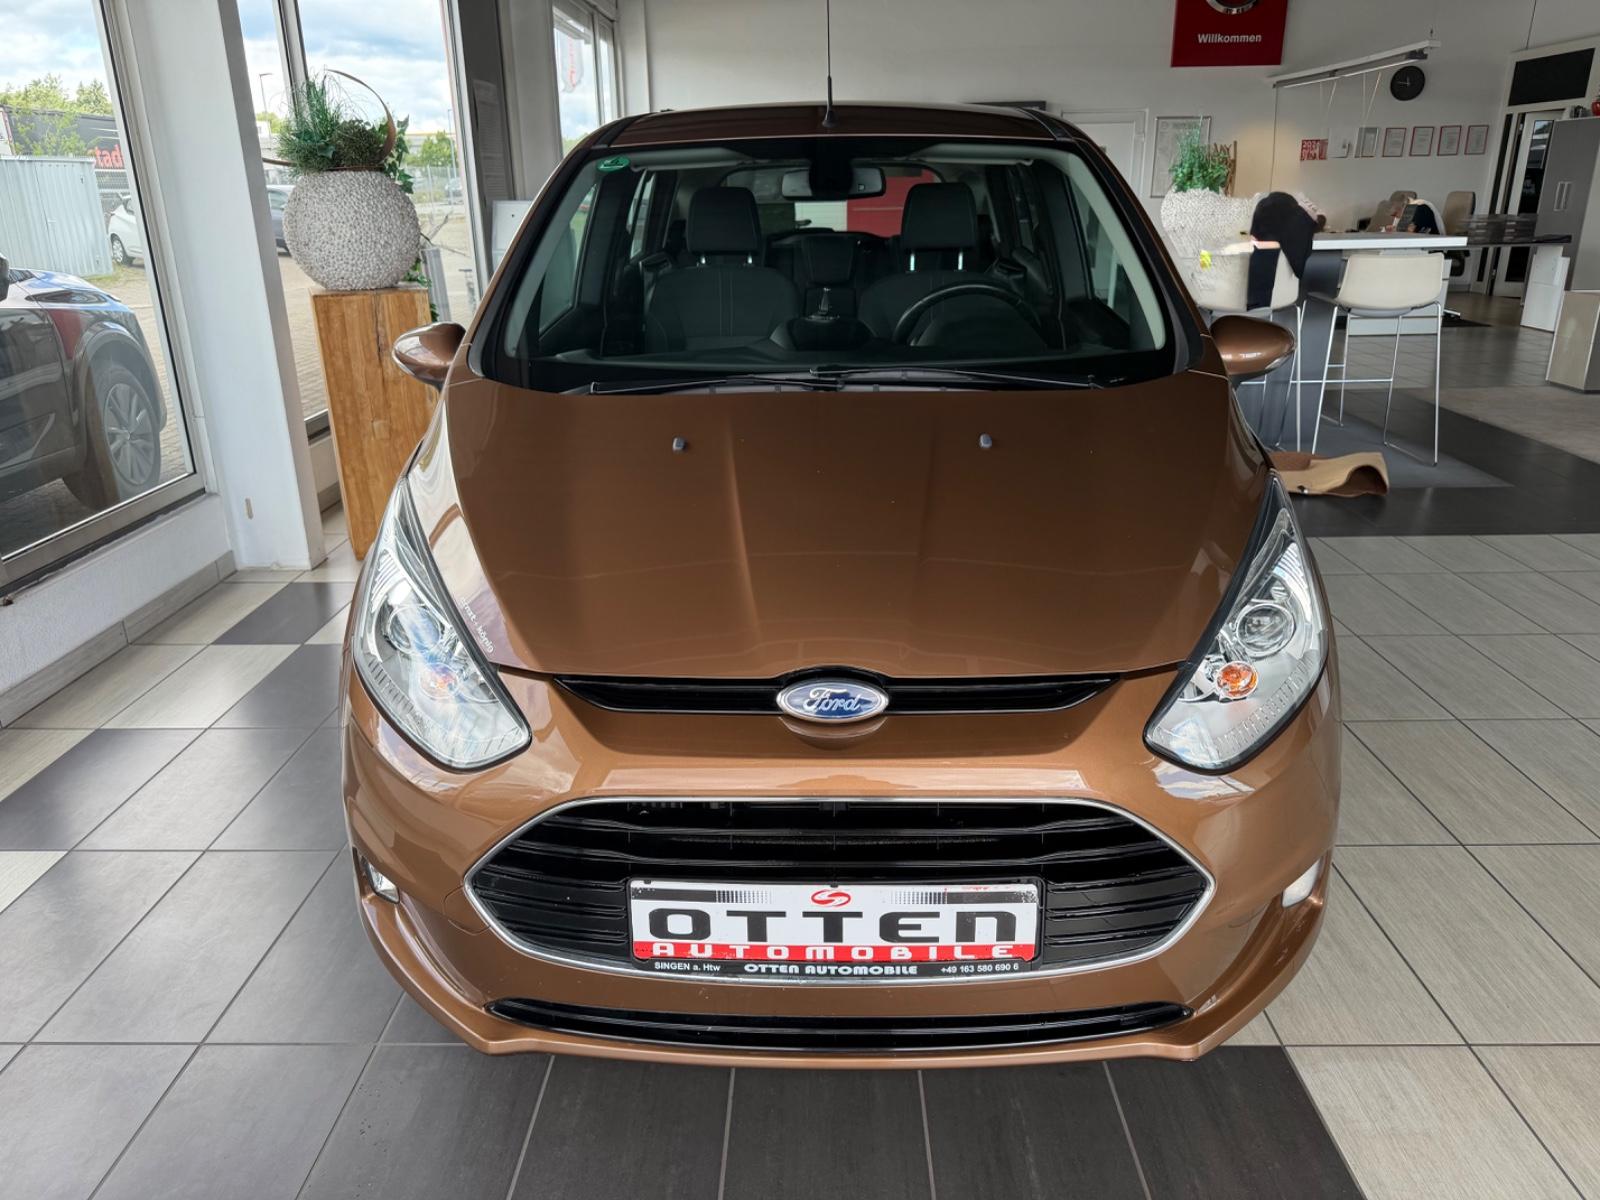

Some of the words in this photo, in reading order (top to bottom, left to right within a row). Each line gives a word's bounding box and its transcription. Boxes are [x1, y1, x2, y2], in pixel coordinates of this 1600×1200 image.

[1197, 33, 1262, 43] Willkommen
[802, 687, 861, 712] Ford
[648, 907, 1017, 943] OTTEN
[652, 942, 1014, 961] AUTOMOBILE
[654, 961, 690, 971] SINGEN
[703, 963, 721, 972] Htw
[744, 964, 800, 974] OTTEN
[804, 965, 918, 975] AUTOMOBILE
[941, 965, 958, 974] +49
[960, 965, 975, 973] 163
[977, 964, 993, 972] 580
[995, 963, 1011, 971] 690
[1013, 962, 1019, 970] 6
